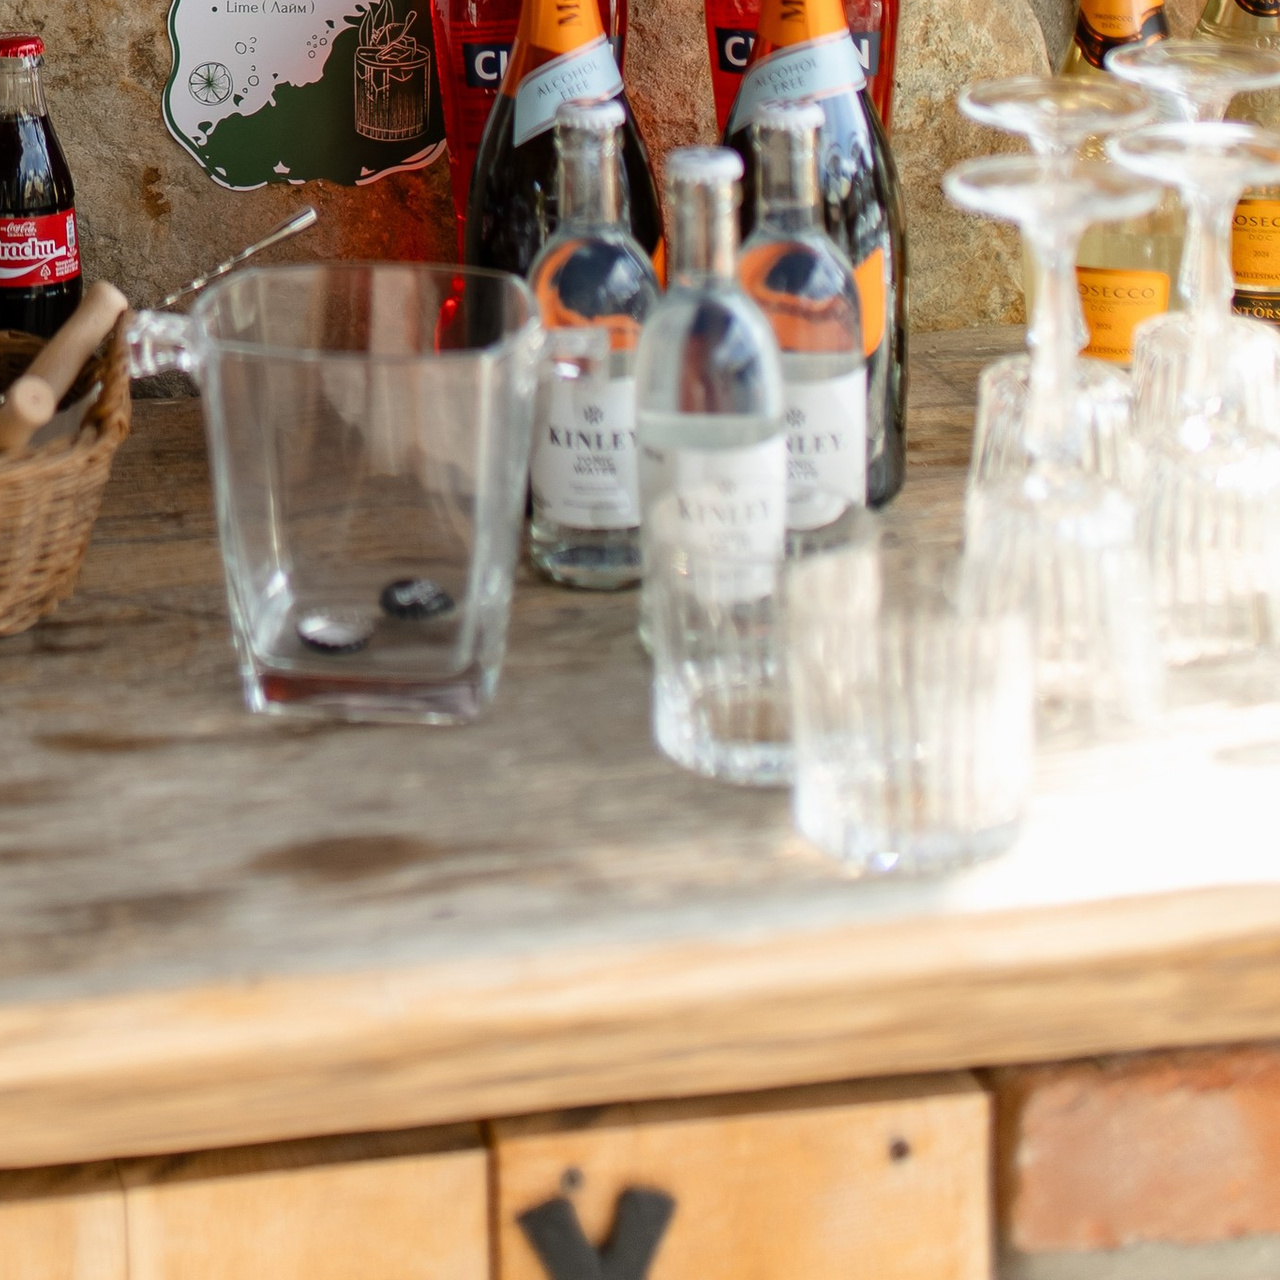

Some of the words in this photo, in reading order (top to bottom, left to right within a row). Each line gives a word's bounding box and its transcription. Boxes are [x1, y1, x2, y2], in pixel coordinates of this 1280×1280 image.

[535, 59, 600, 98] ALCOHOL
[755, 57, 819, 90] ALCOHOL
[773, 75, 807, 95] FREE
[559, 78, 591, 102] FREE
